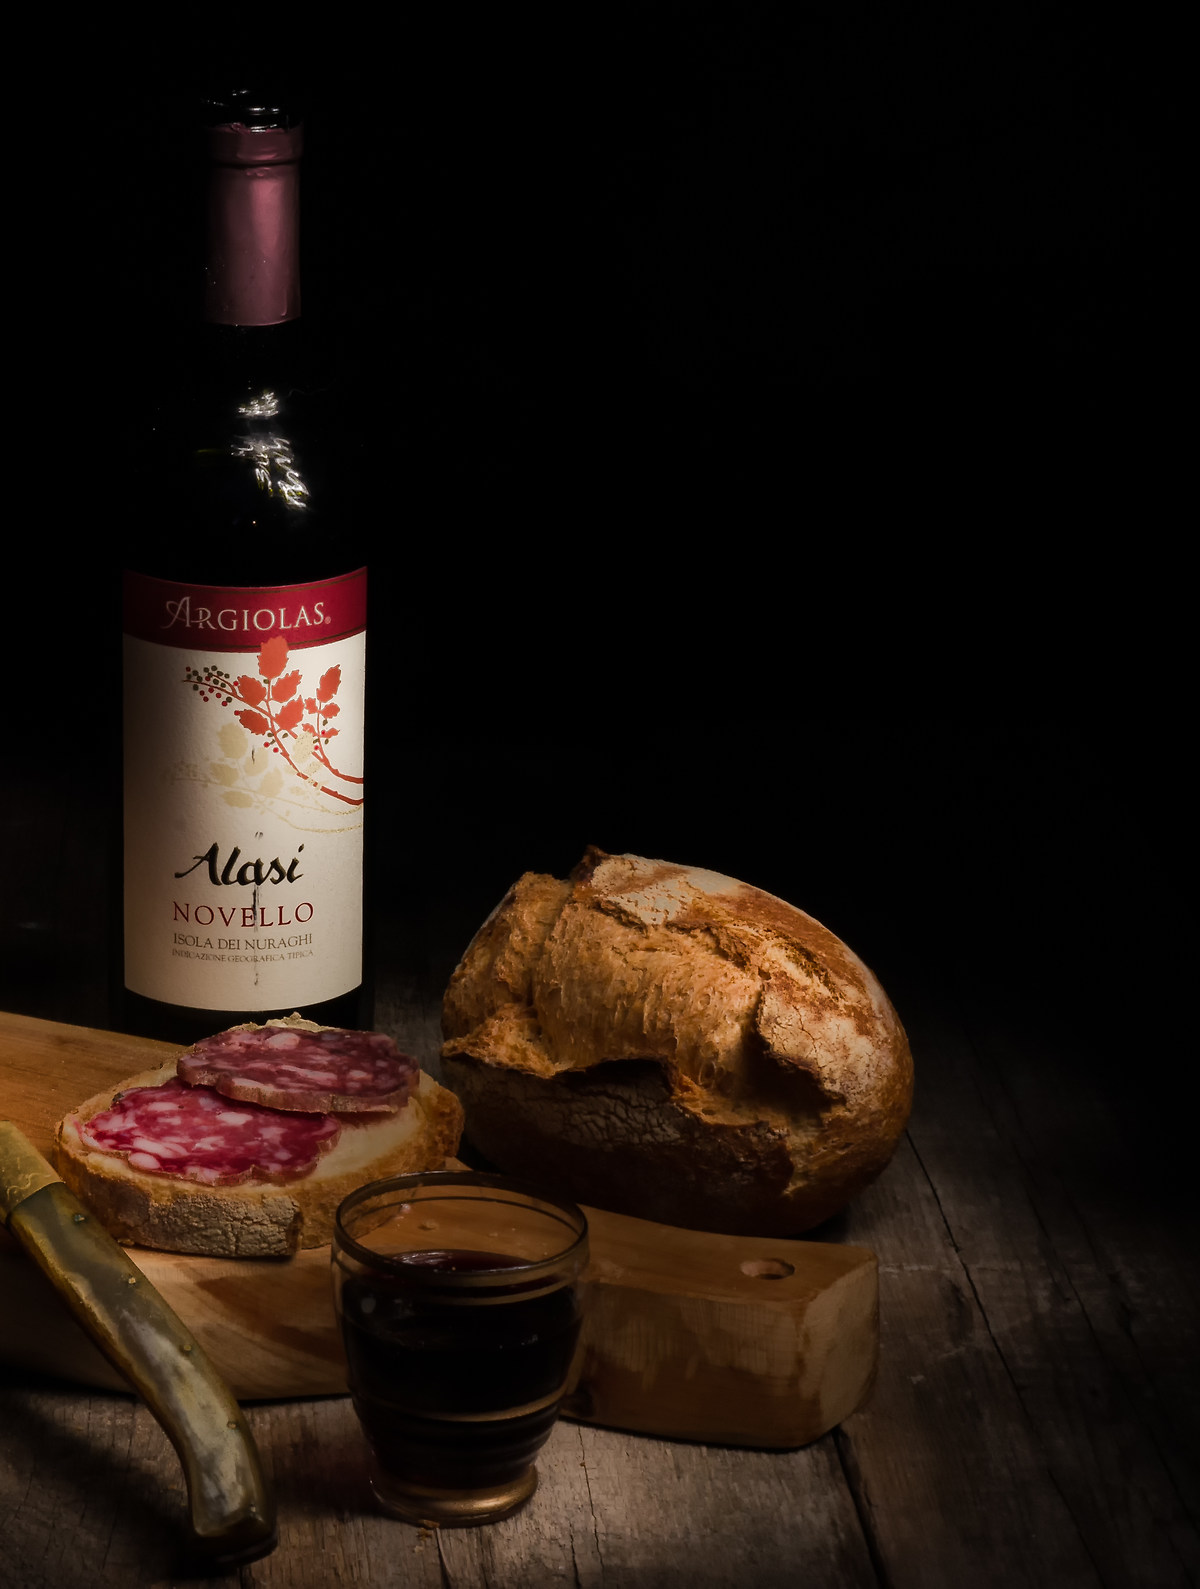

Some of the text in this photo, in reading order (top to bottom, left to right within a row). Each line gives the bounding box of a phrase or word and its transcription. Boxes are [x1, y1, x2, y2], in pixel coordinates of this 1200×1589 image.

[159, 596, 326, 632] ARGIOLAS
[174, 842, 305, 886] Alasi
[172, 901, 314, 928] NOVELLO
[173, 933, 313, 950] ISOLA DEI NURAGHI
[172, 949, 314, 963] INDICAZIONE GEOGRAFICA TIPICA
